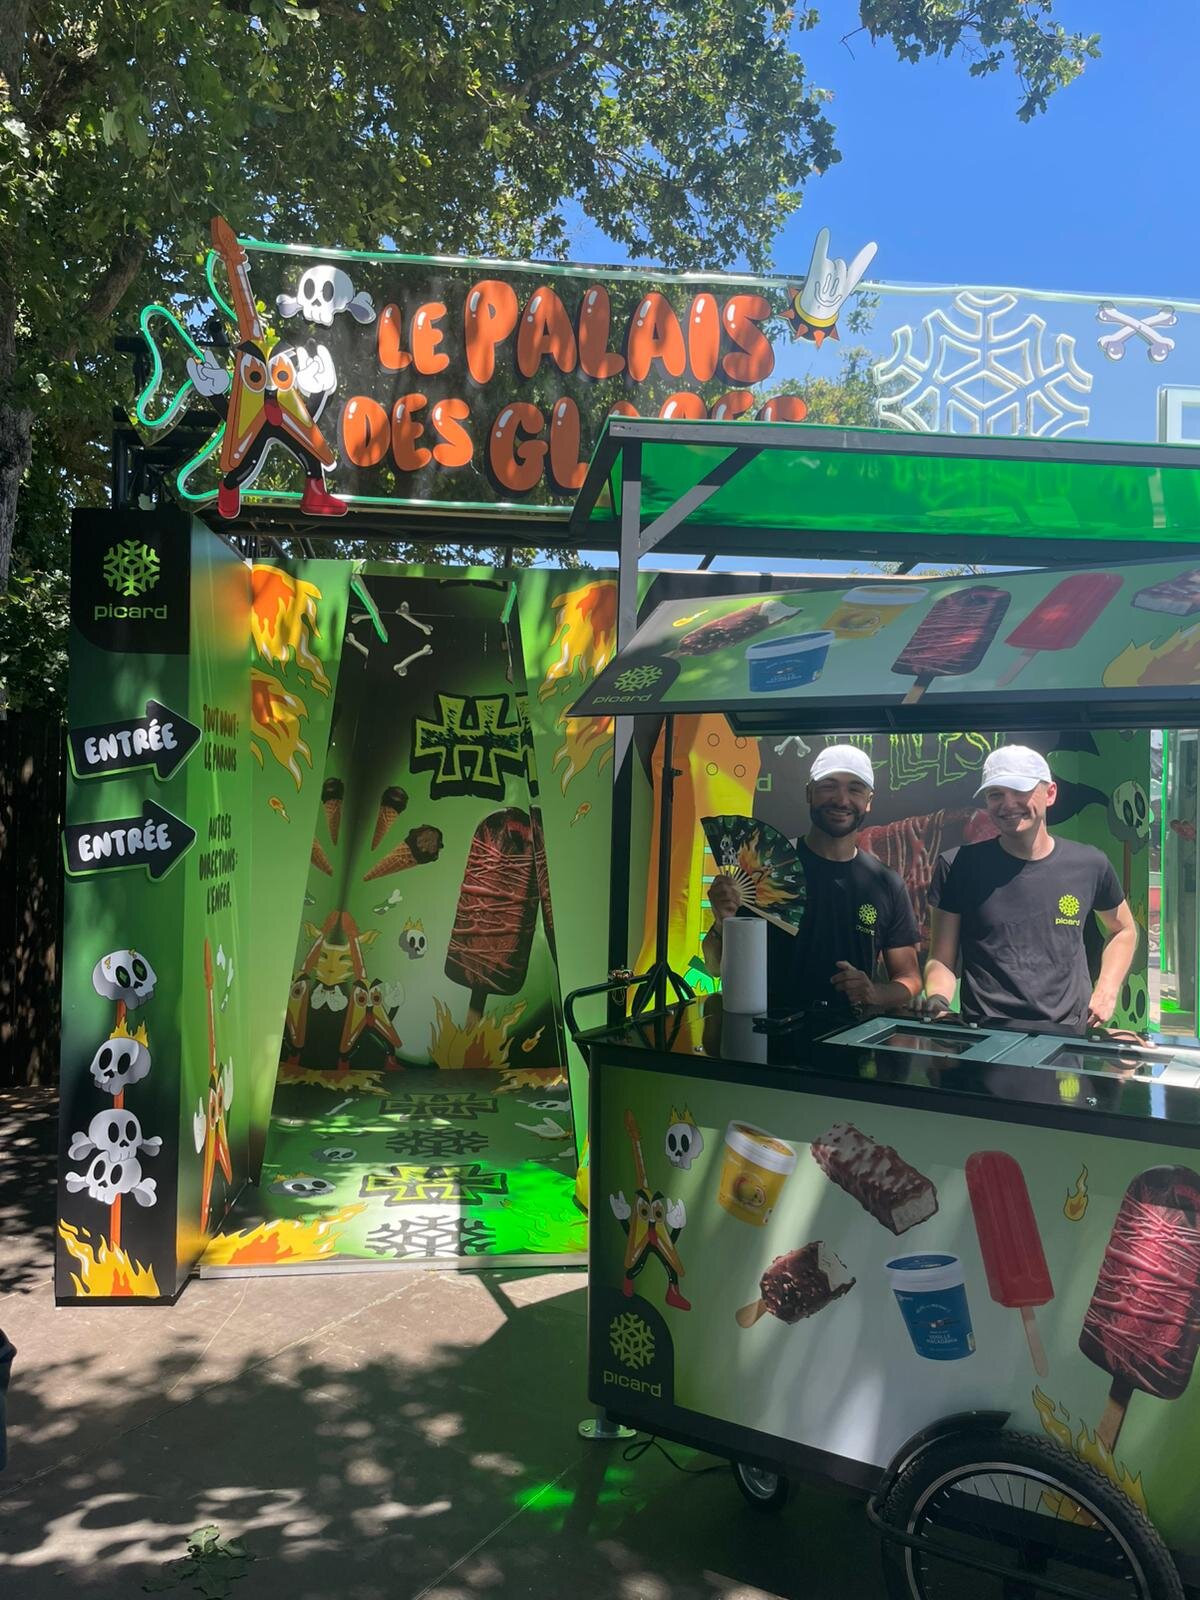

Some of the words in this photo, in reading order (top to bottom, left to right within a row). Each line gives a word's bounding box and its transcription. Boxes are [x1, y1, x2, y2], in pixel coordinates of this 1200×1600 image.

[377, 302, 450, 375] LE
[464, 279, 776, 384] PALAIS
[342, 393, 474, 472] DES
[94, 604, 168, 621] picard
[592, 694, 652, 705] picard
[84, 718, 178, 765] ENTRÉE
[77, 818, 172, 862] ENTRÉE
[208, 812, 232, 842] AUTRES
[1055, 917, 1081, 926] picard
[603, 1370, 662, 1398] picard
